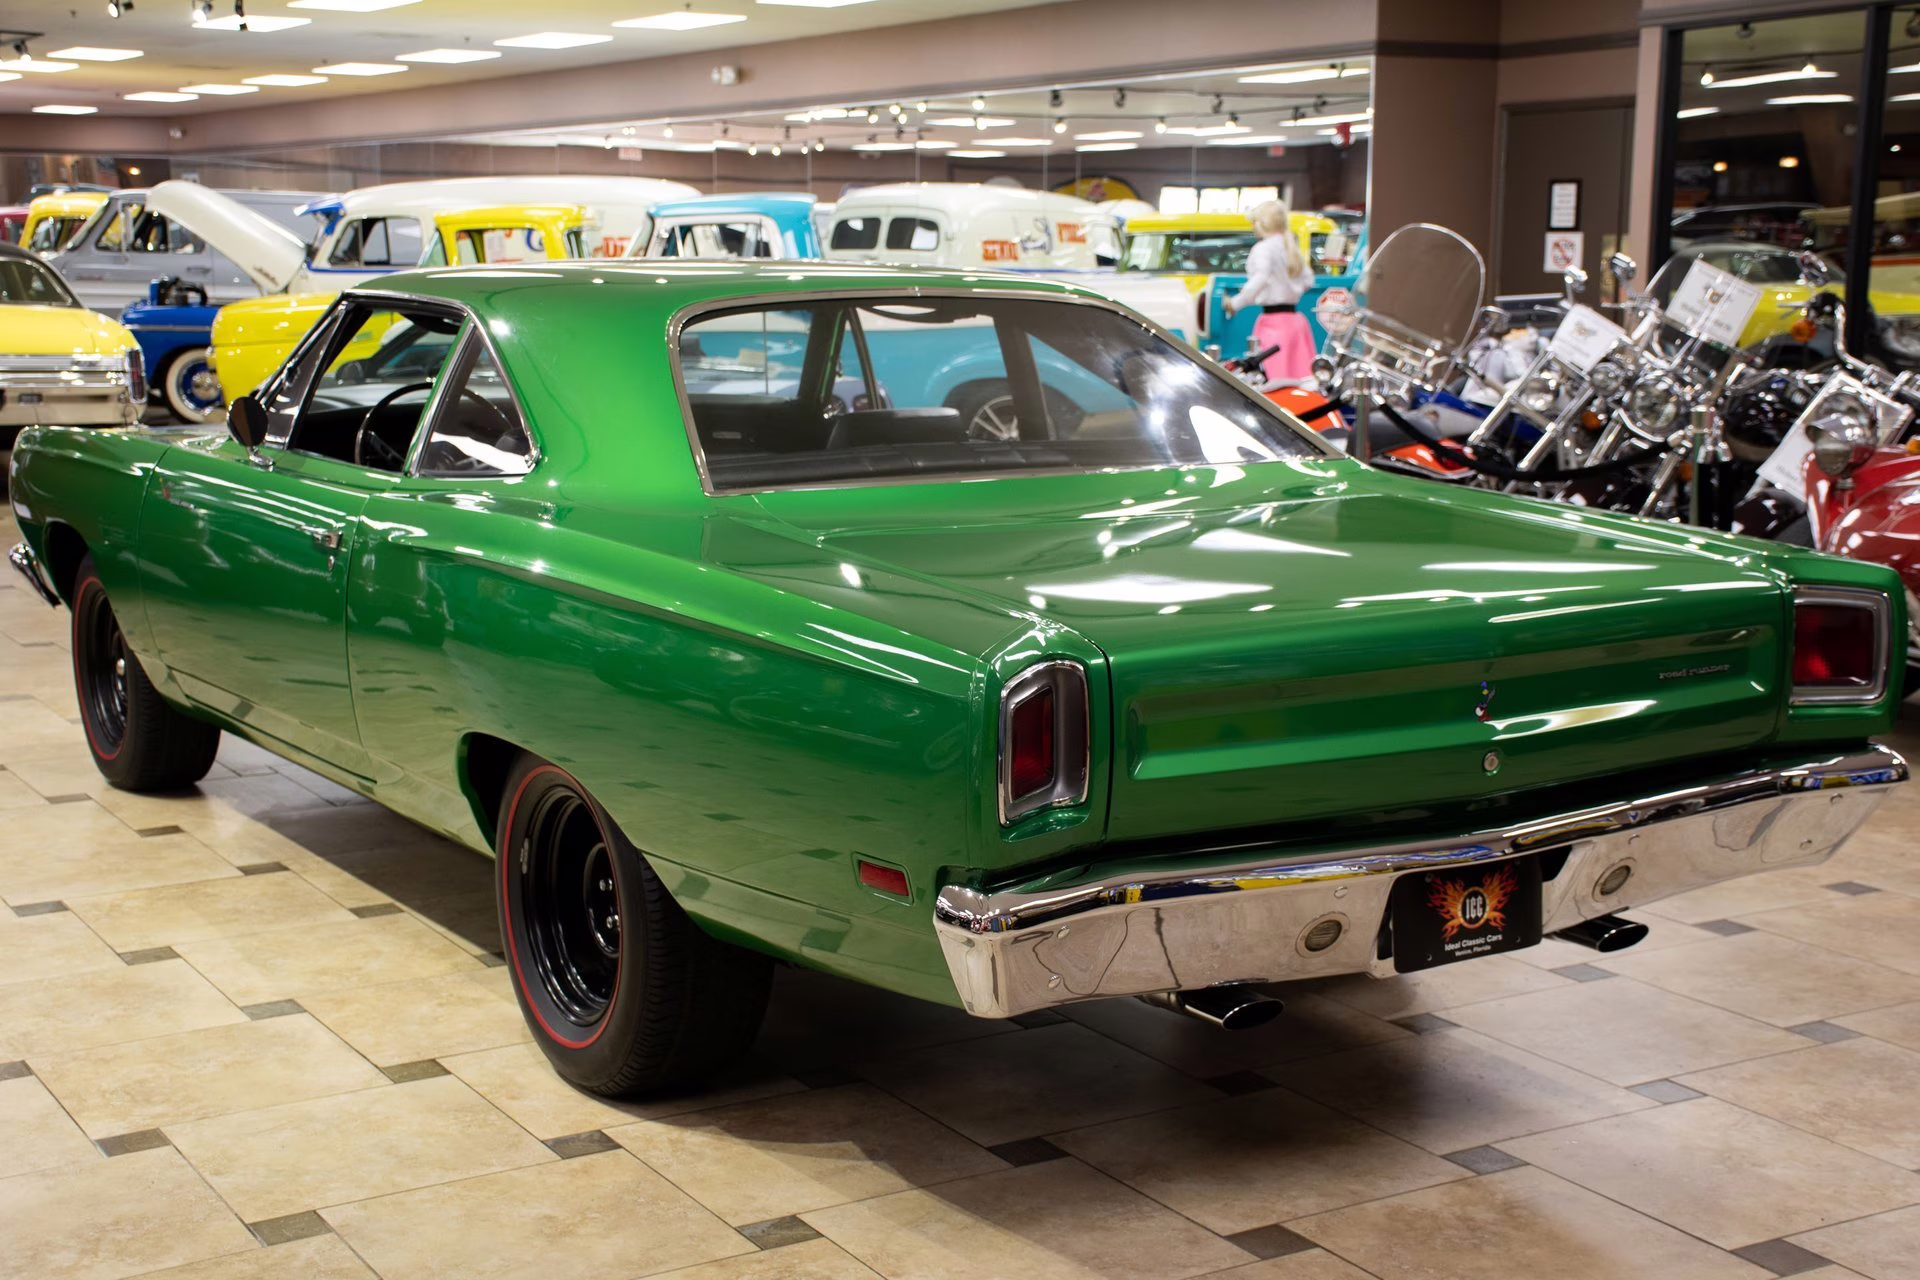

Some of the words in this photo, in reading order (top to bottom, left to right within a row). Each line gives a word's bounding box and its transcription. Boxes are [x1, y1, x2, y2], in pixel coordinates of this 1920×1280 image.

[1445, 941, 1461, 951] Ideal
[1462, 937, 1485, 947] Classic
[1486, 934, 1502, 942] Cars
